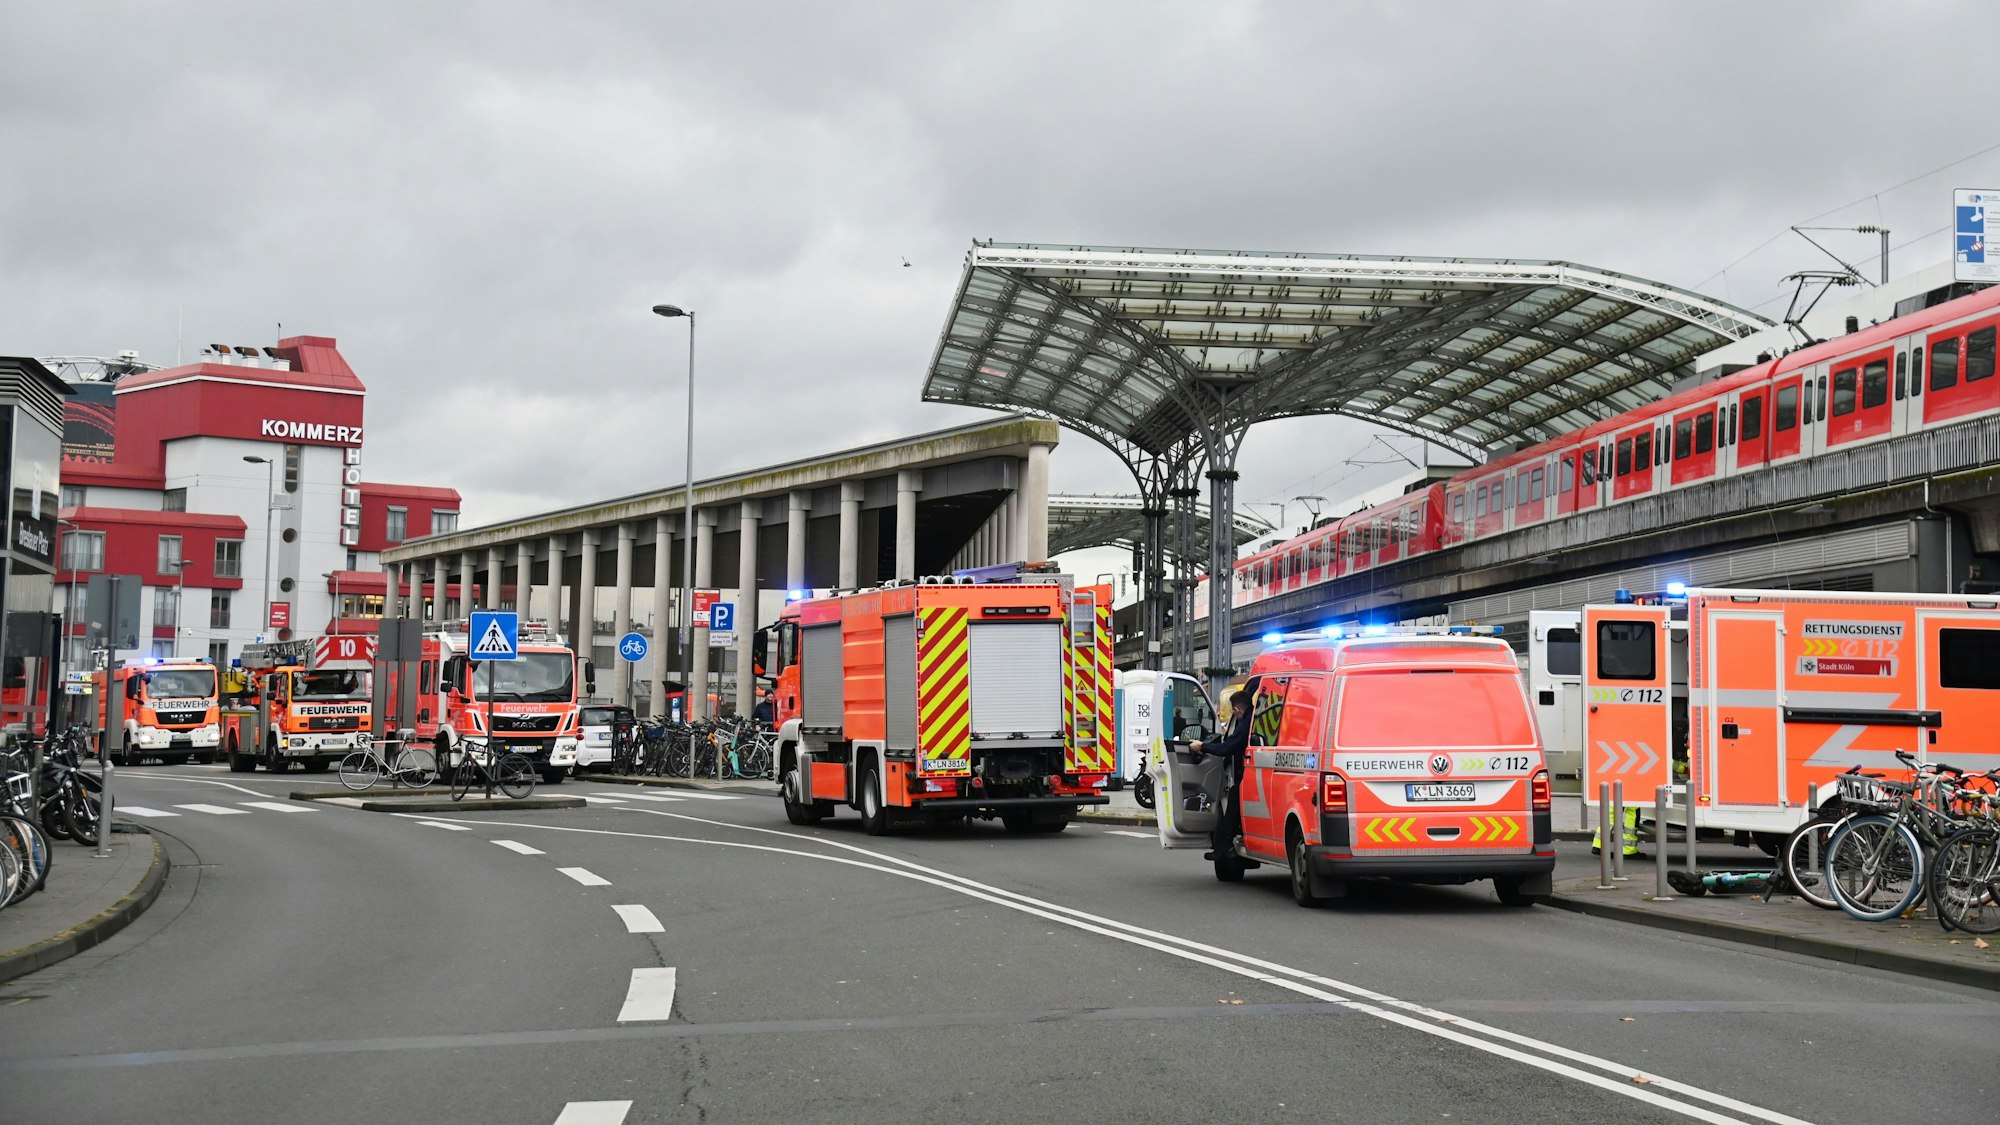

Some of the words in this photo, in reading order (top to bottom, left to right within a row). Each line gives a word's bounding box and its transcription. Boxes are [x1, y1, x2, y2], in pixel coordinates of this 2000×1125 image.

[262, 419, 362, 443] KOMMERZ
[345, 448, 360, 545] HOTEL
[38, 530, 48, 556] Platz
[1805, 624, 1902, 636] RETTUNGSDIENST
[340, 638, 356, 657] 10
[1865, 640, 1899, 658] 112
[1818, 662, 1838, 670] Stadt
[1838, 662, 1854, 670] Köln
[1638, 688, 1663, 702] 112
[152, 700, 210, 709] FEUERWEHR
[300, 706, 368, 715] FEUERWEHR
[500, 704, 548, 713] Feuerwehr
[1275, 752, 1316, 768] EINSATZLEITUNG
[1346, 760, 1424, 770] FEUERWEHR
[1506, 756, 1528, 770] 112
[1414, 786, 1422, 797] K
[1429, 786, 1444, 797] LN
[1446, 786, 1472, 796] 3669
